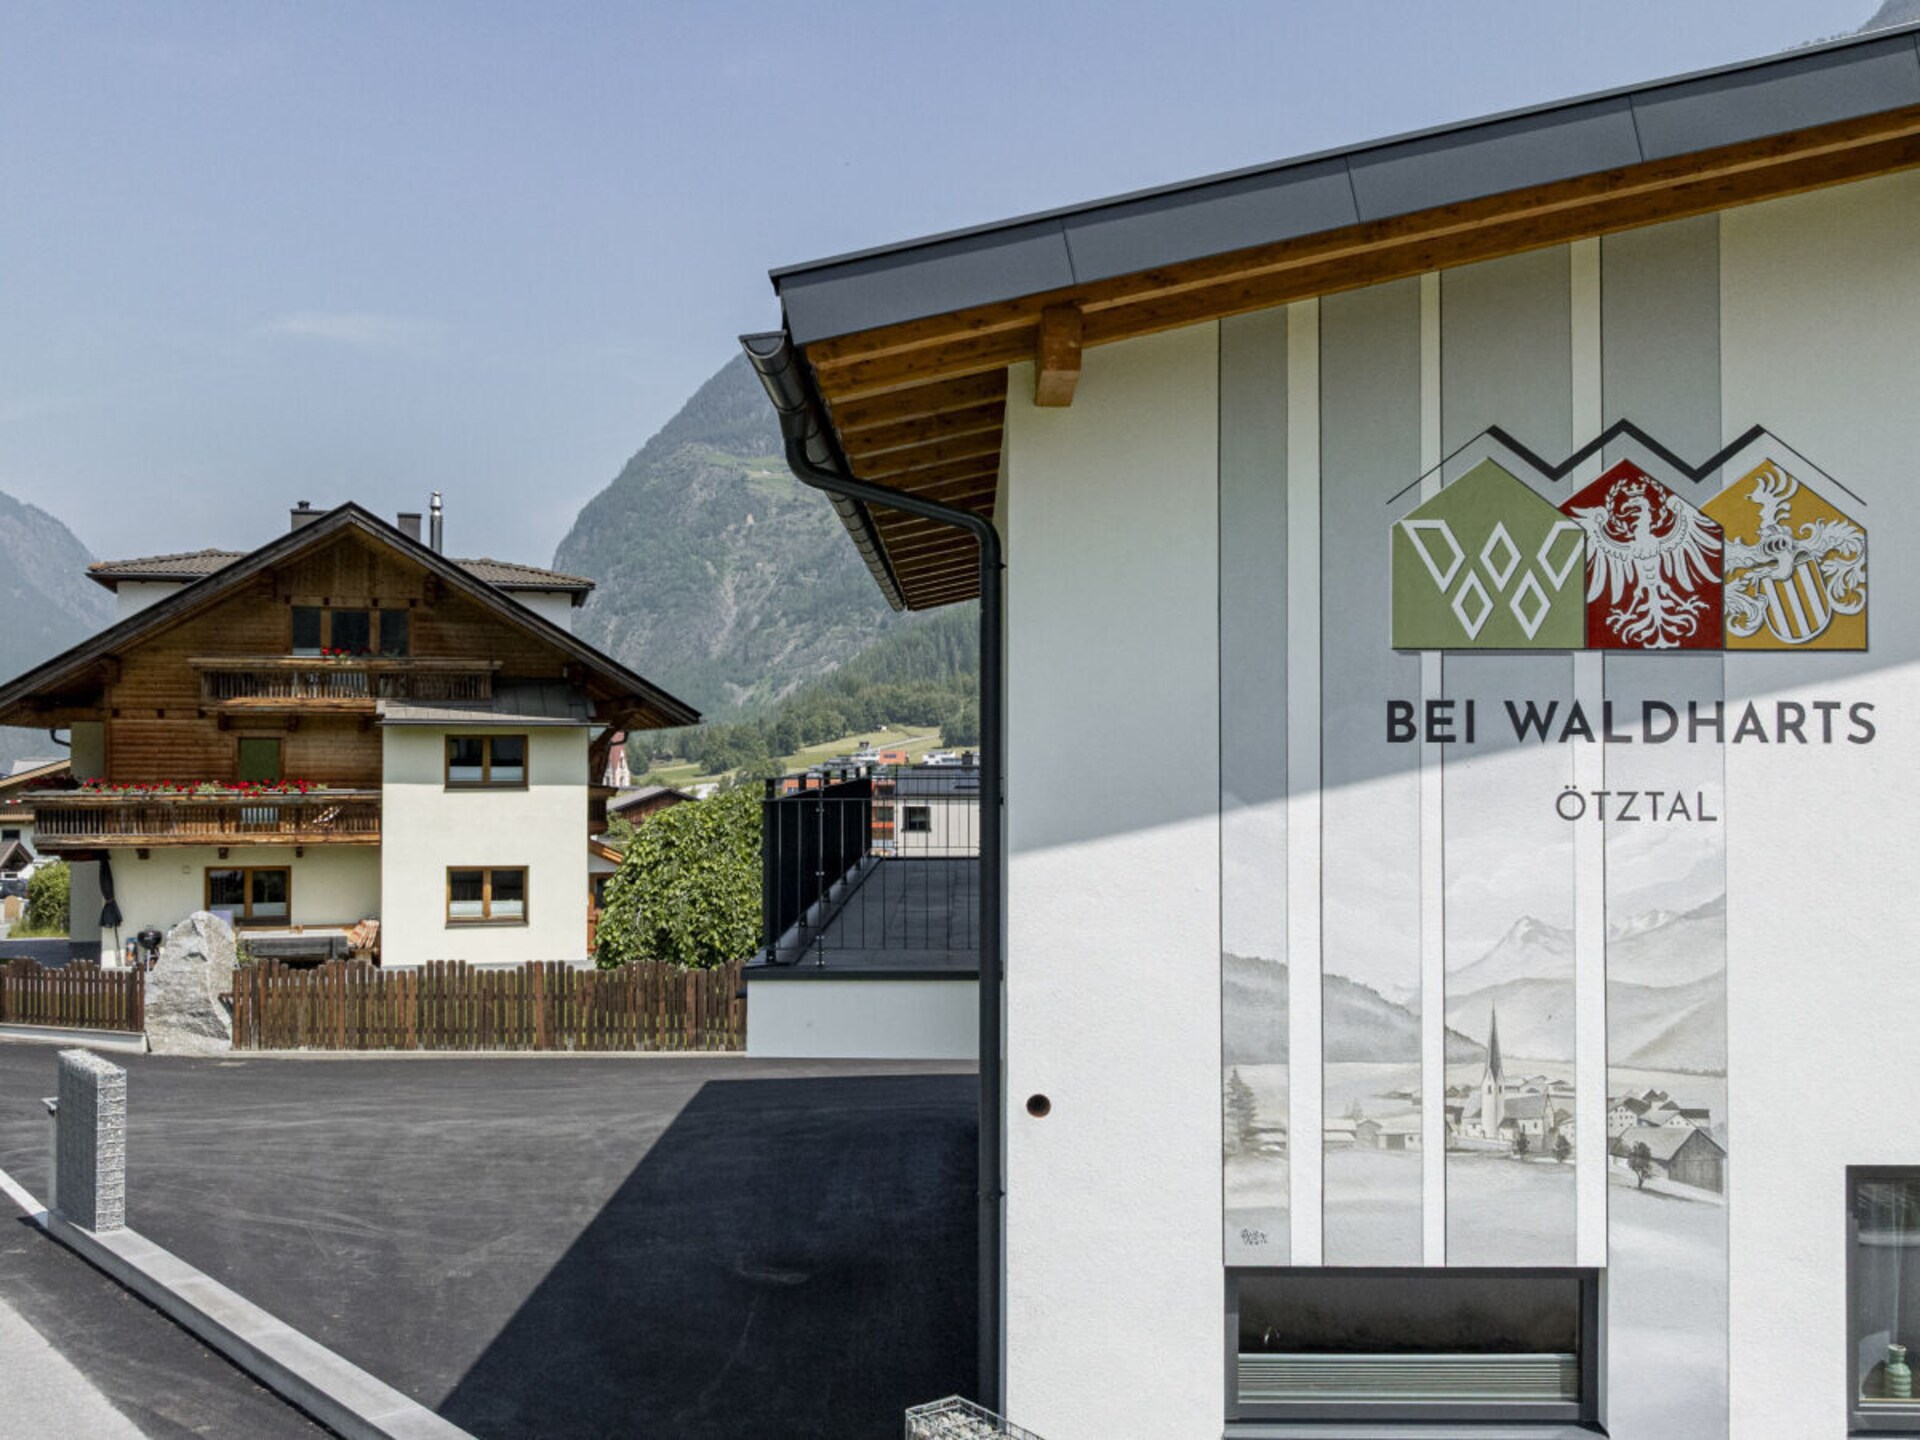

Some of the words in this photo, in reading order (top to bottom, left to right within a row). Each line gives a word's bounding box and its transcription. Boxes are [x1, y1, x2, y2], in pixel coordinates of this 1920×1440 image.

[1386, 699, 1475, 743] BEI
[1504, 699, 1877, 744] WALDHARTS
[1555, 785, 1718, 822] ÖTZTAL
